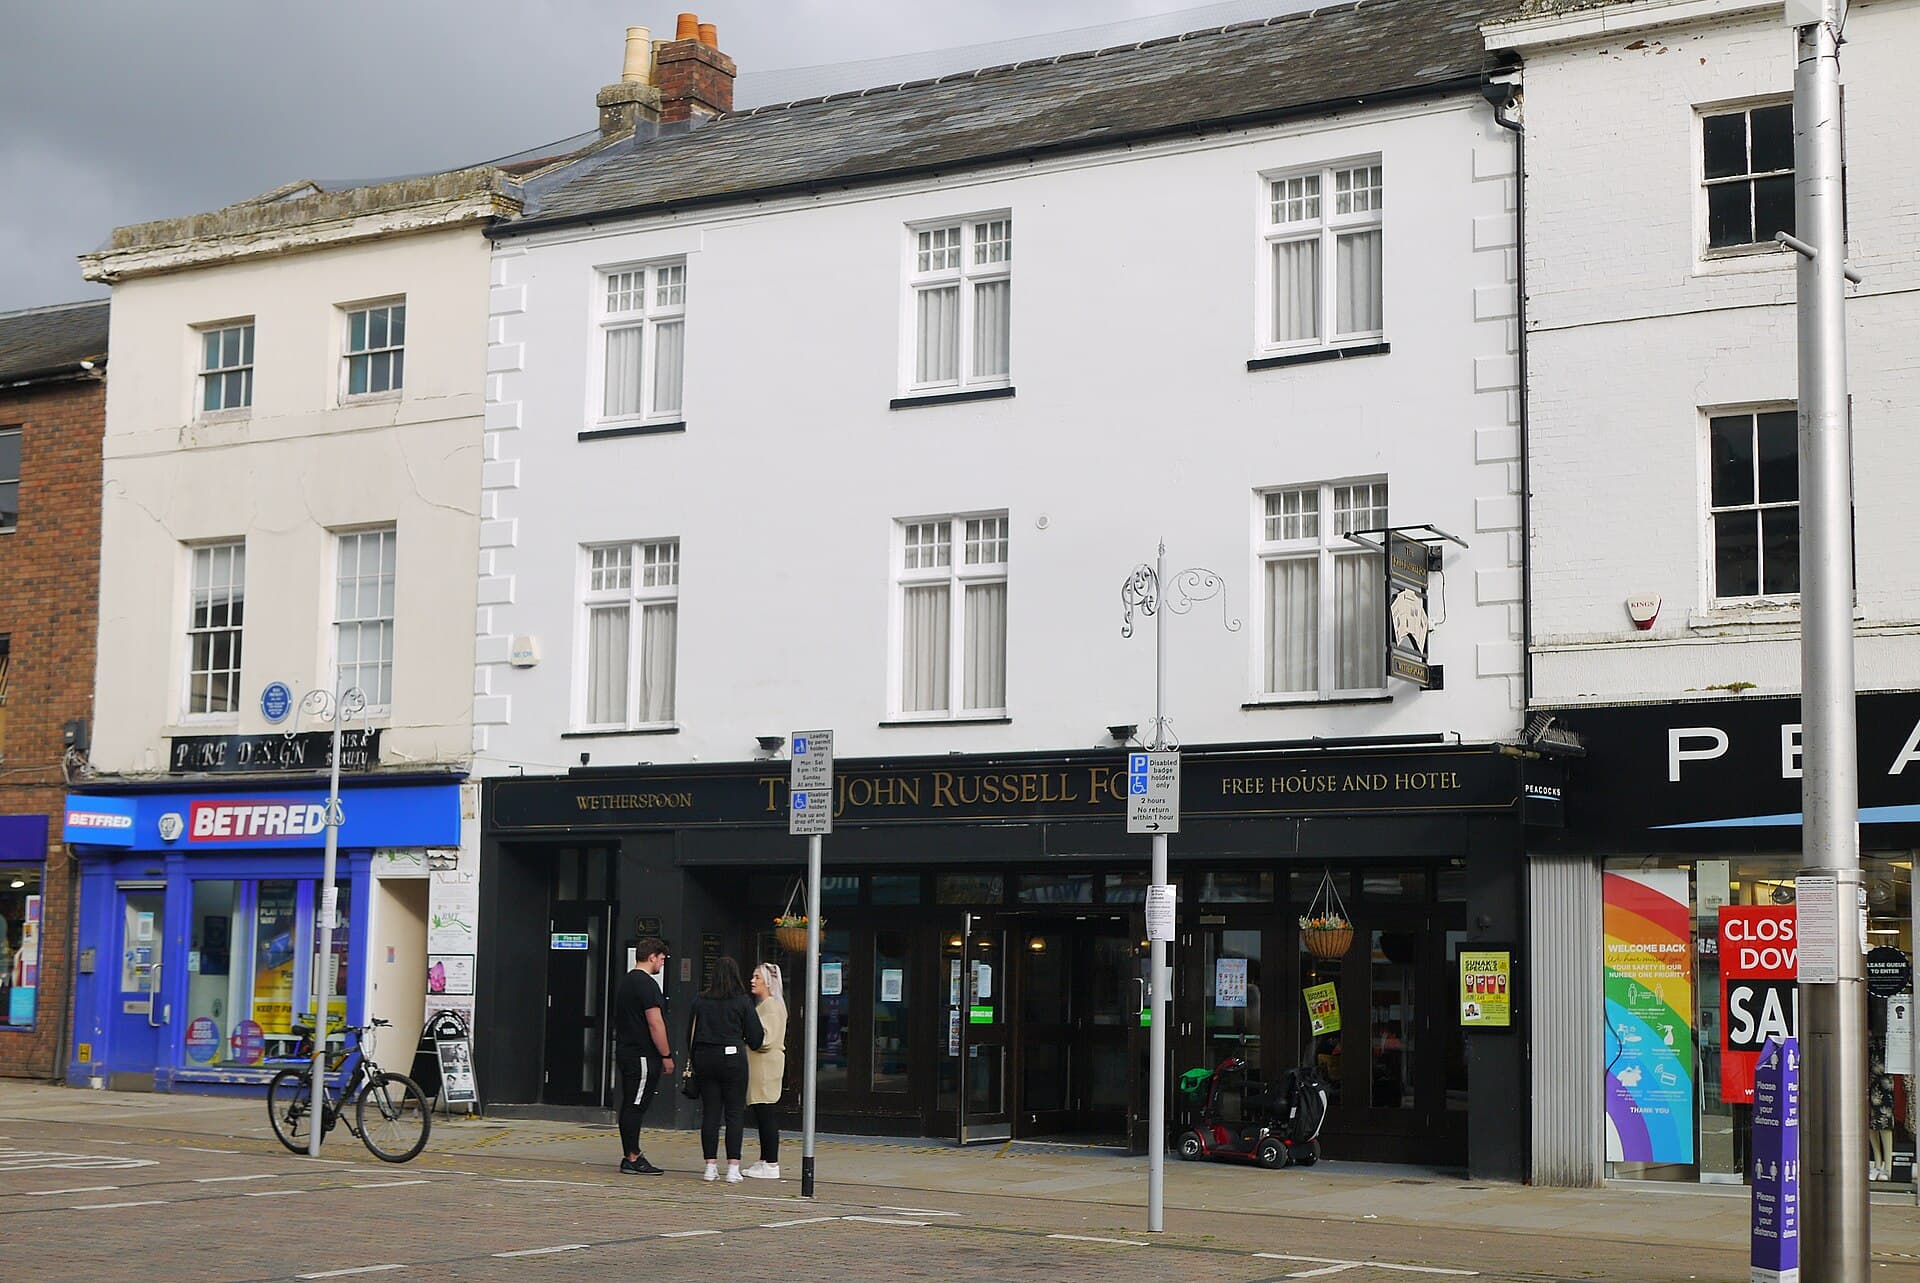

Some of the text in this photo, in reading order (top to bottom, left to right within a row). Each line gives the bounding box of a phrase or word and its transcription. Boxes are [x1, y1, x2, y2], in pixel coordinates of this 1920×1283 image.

[1631, 600, 1655, 608] KINGS
[177, 739, 309, 769] PRE DSGN
[325, 750, 368, 767] BAUTY
[1135, 756, 1145, 773] P
[1222, 771, 1462, 795] FREE HOUSE AND HOTEL
[834, 775, 921, 818] JOHN
[932, 772, 1078, 808] RUSSELL
[1088, 767, 1129, 805] FO
[1525, 784, 1560, 797] PEACOCKS
[576, 793, 693, 810] WETHERSPOON
[68, 812, 132, 829] BETFRED
[193, 804, 327, 837] BETFRED
[1725, 918, 1797, 941] CLOS
[1608, 944, 1686, 953] WELCOME BACK
[1741, 947, 1797, 970] DOW
[1757, 1081, 1776, 1090] Please
[1759, 1093, 1774, 1104] keep
[1759, 1106, 1773, 1114] your
[1754, 1116, 1780, 1126] distance
[1756, 1191, 1776, 1202] Please
[1758, 1203, 1773, 1215] keep
[1759, 1217, 1772, 1226] your
[1753, 1227, 1778, 1239] distance
